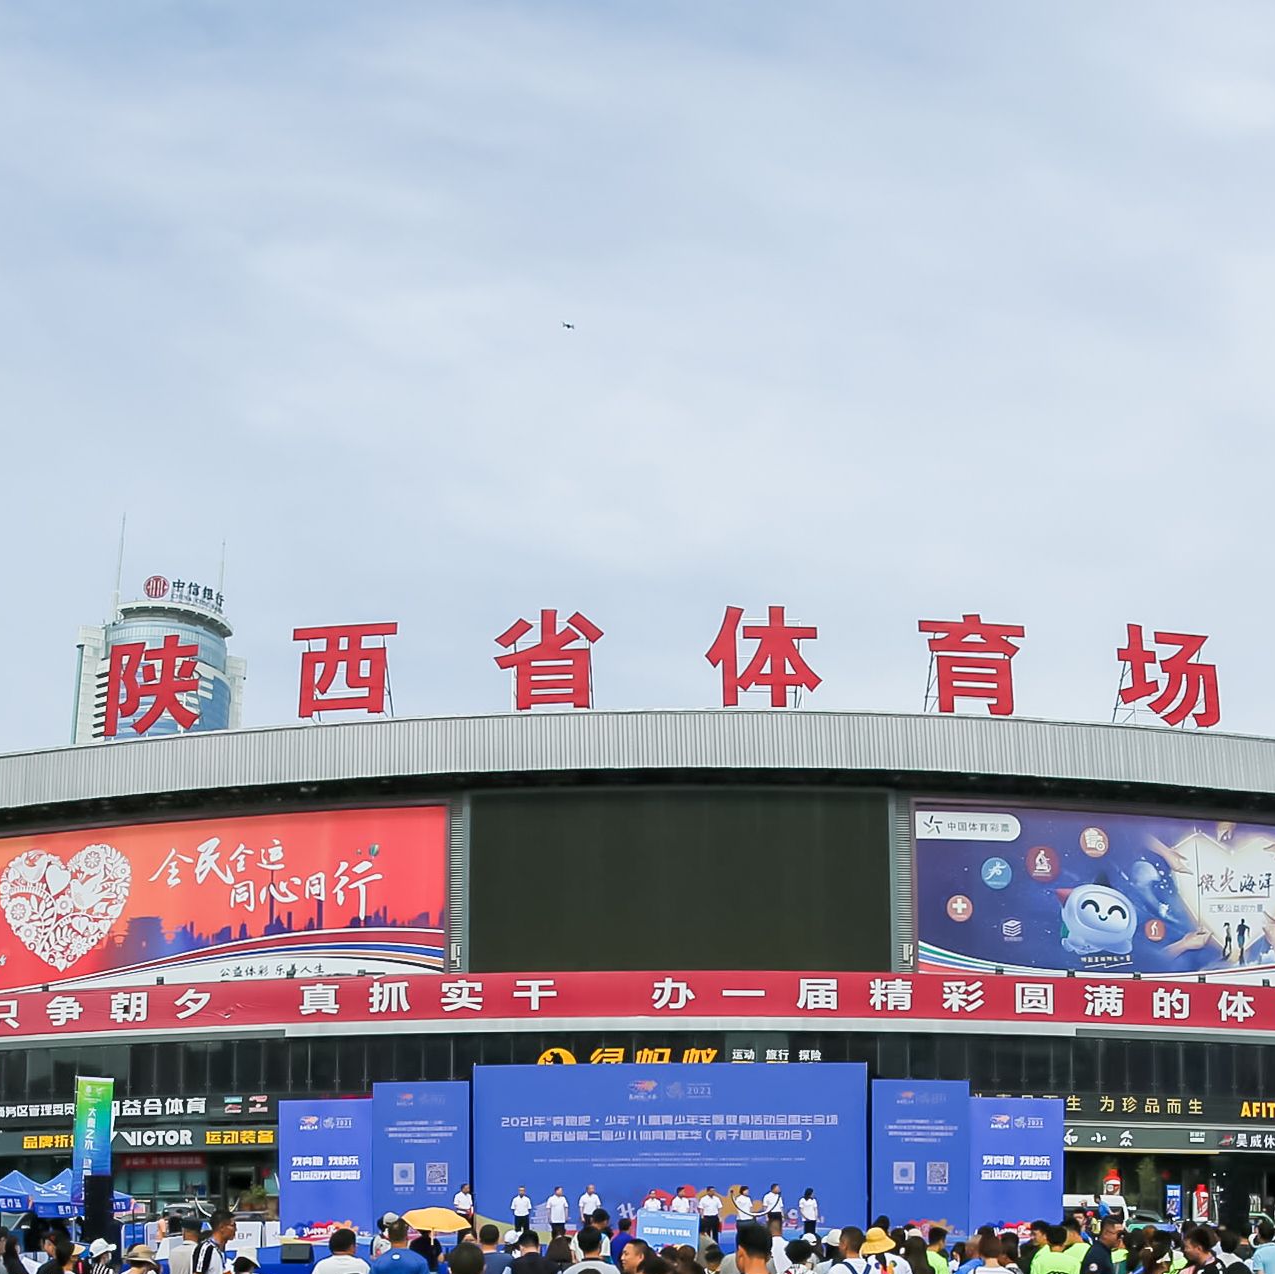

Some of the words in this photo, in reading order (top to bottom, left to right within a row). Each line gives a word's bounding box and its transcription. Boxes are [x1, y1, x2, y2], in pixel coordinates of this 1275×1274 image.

[172, 579, 225, 607] 中信银行
[102, 605, 1221, 737] 陕西省体育场
[946, 820, 1011, 834] 中国体育彩票
[148, 836, 285, 888] 全民全运
[229, 858, 383, 920] 同心同行
[298, 979, 558, 1015] 真抓实干
[731, 1048, 755, 1061] 运动
[766, 1048, 789, 1061] 旅行
[798, 1049, 822, 1061] 探险
[1099, 1095, 1204, 1116] 为珍品而生
[119, 1129, 193, 1146] VICTOR
[205, 1129, 274, 1145] 运动装备
